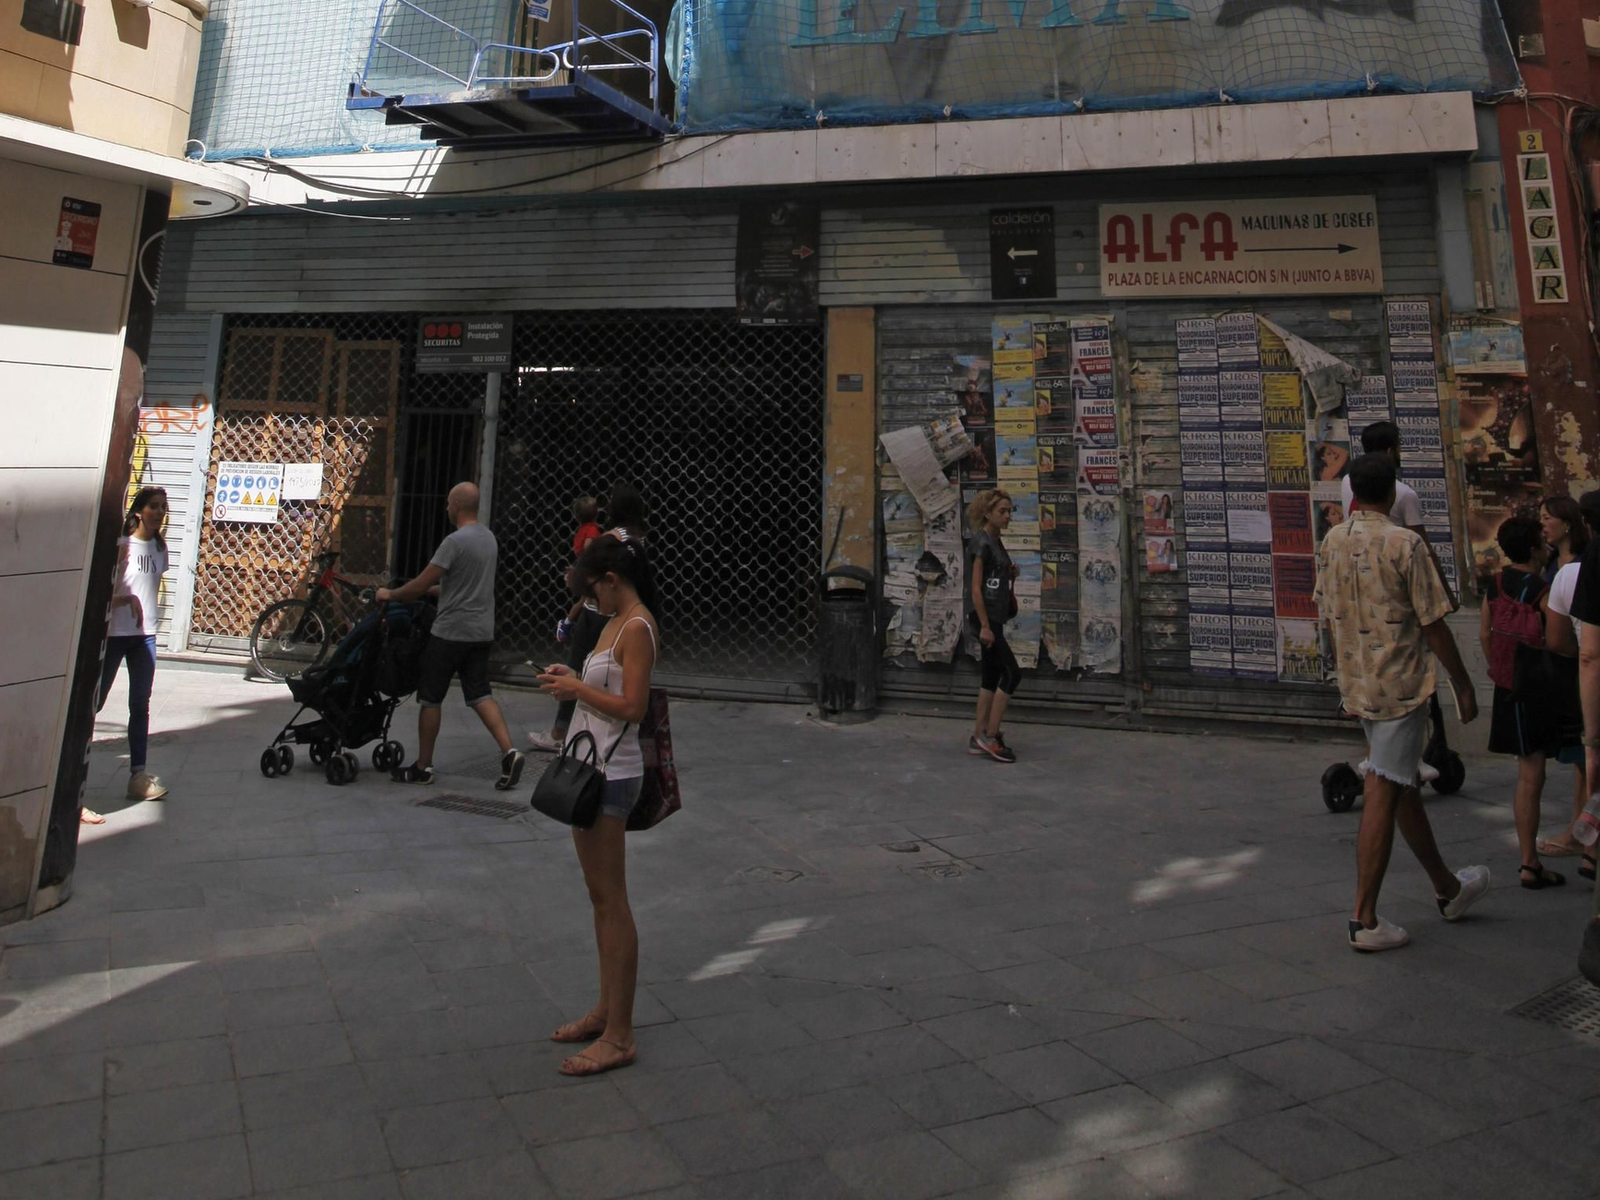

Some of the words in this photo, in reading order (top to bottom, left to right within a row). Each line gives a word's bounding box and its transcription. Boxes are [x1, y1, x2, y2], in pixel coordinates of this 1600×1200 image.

[1526, 135, 1537, 150] 2
[1241, 213, 1309, 231] MAQUINAS
[1313, 213, 1330, 229] DE
[1332, 211, 1374, 228] COSER
[1523, 157, 1564, 300] LAGAR
[1103, 211, 1238, 263] ALFA
[1108, 271, 1142, 287] PLAZA
[1145, 271, 1160, 286] DE
[1162, 271, 1177, 285] LA
[1180, 267, 1267, 285] ENCARNACIÓN
[1270, 269, 1289, 284] S/N
[1292, 269, 1331, 286] (JUNTO
[1334, 269, 1342, 282] A
[1344, 268, 1376, 284] BBVA)
[1389, 303, 1428, 312] KIROS
[467, 322, 504, 330] Instalación
[1178, 320, 1214, 328] KIROS
[1390, 323, 1430, 332] SUPERIOR
[467, 331, 499, 340] Protegida
[1218, 333, 1255, 342] SUPERIOR
[423, 338, 461, 347] SECURITAS
[1179, 339, 1216, 347] SUPERIOR
[1180, 374, 1217, 382] KIROS
[1221, 373, 1258, 381] KIROS
[1395, 378, 1435, 387] SUPERIOR
[1181, 393, 1217, 401] SUPERIOR
[1222, 392, 1259, 400] SUPERIOR
[1349, 397, 1387, 406] SUPERIOR
[1398, 417, 1438, 425] KIROS
[1182, 432, 1219, 440] KIROS
[1224, 432, 1262, 440] KIROS
[1400, 437, 1439, 446] SUPERIOR
[1183, 451, 1220, 460] SUPERIOR
[1225, 452, 1263, 460] SUPERIOR
[1404, 479, 1445, 488] KIROS
[1185, 492, 1222, 500] KIROS
[1227, 493, 1266, 501] KIROS
[1418, 491, 1446, 500] OMASAJE
[1421, 501, 1447, 510] ERIOR
[1186, 512, 1223, 520] SUPERIOR
[1188, 553, 1227, 561] KIROS
[1232, 554, 1270, 563] KIROS
[137, 554, 157, 574] 90's
[1189, 573, 1227, 582] SUPERIOR
[1232, 574, 1271, 584] SUPERIOR
[1190, 615, 1229, 624] KIROS
[1234, 617, 1273, 627] KIROS
[1191, 636, 1230, 646] SUPERIOR
[1235, 638, 1274, 648] SUPERIOR
